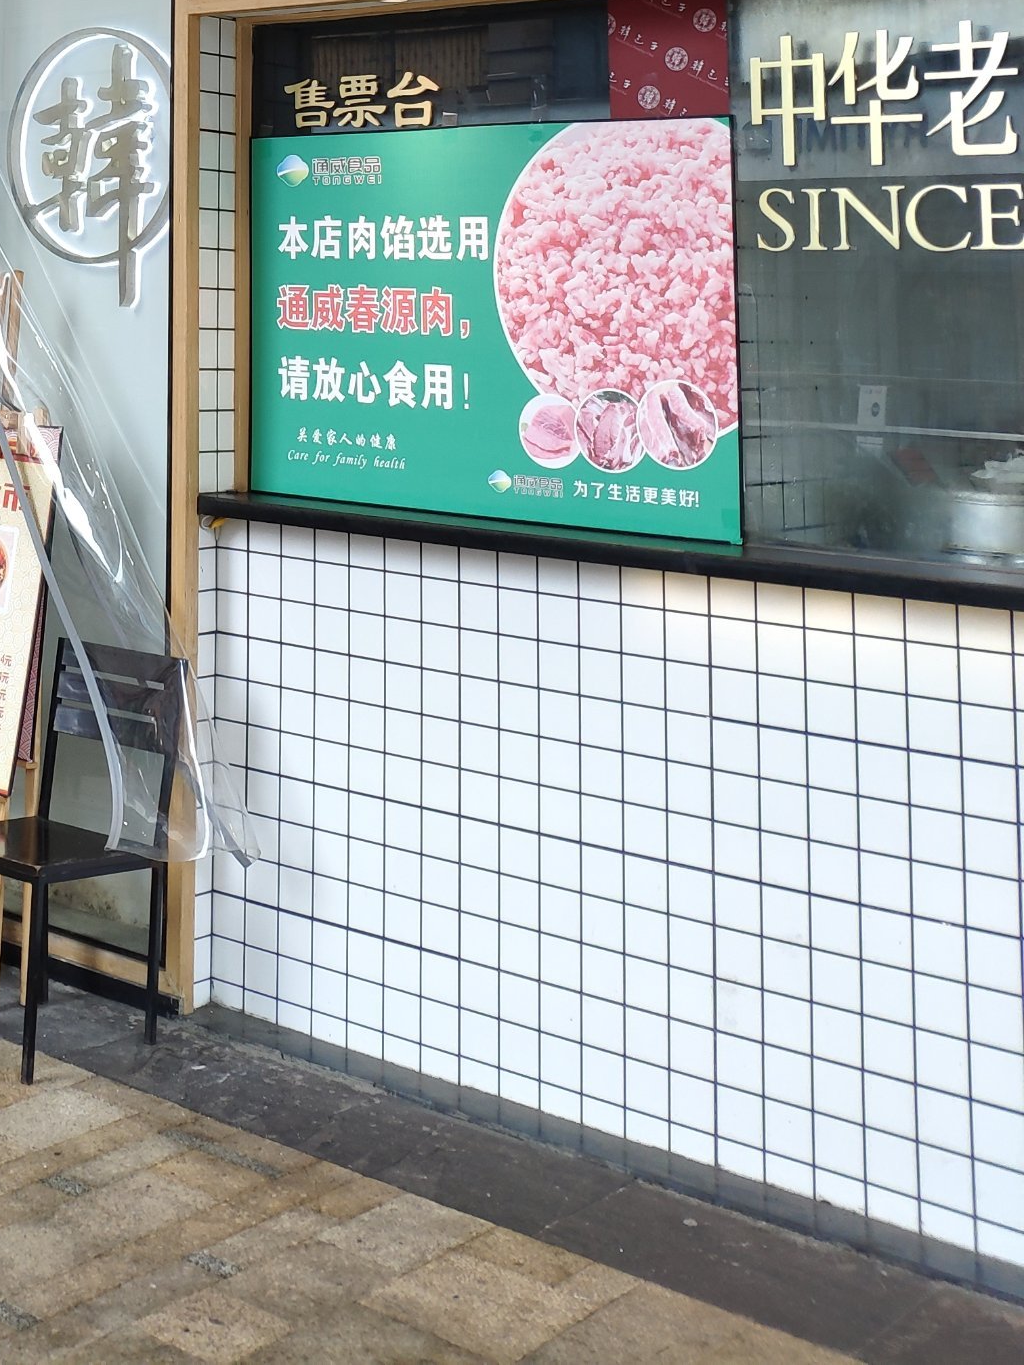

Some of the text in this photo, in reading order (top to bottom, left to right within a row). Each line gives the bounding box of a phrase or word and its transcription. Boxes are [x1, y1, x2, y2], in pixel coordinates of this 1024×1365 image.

[283, 70, 440, 128] 售票台
[750, 19, 1020, 167] 中华老
[311, 155, 383, 176] 通威食品
[312, 174, 383, 187] TONGWEI
[756, 182, 1024, 254] SINCE
[277, 214, 490, 262] 本店肉馅选用
[296, 426, 397, 451] 关爱家人的健康
[287, 449, 406, 471] Care for family health
[513, 474, 564, 491] 通威食品
